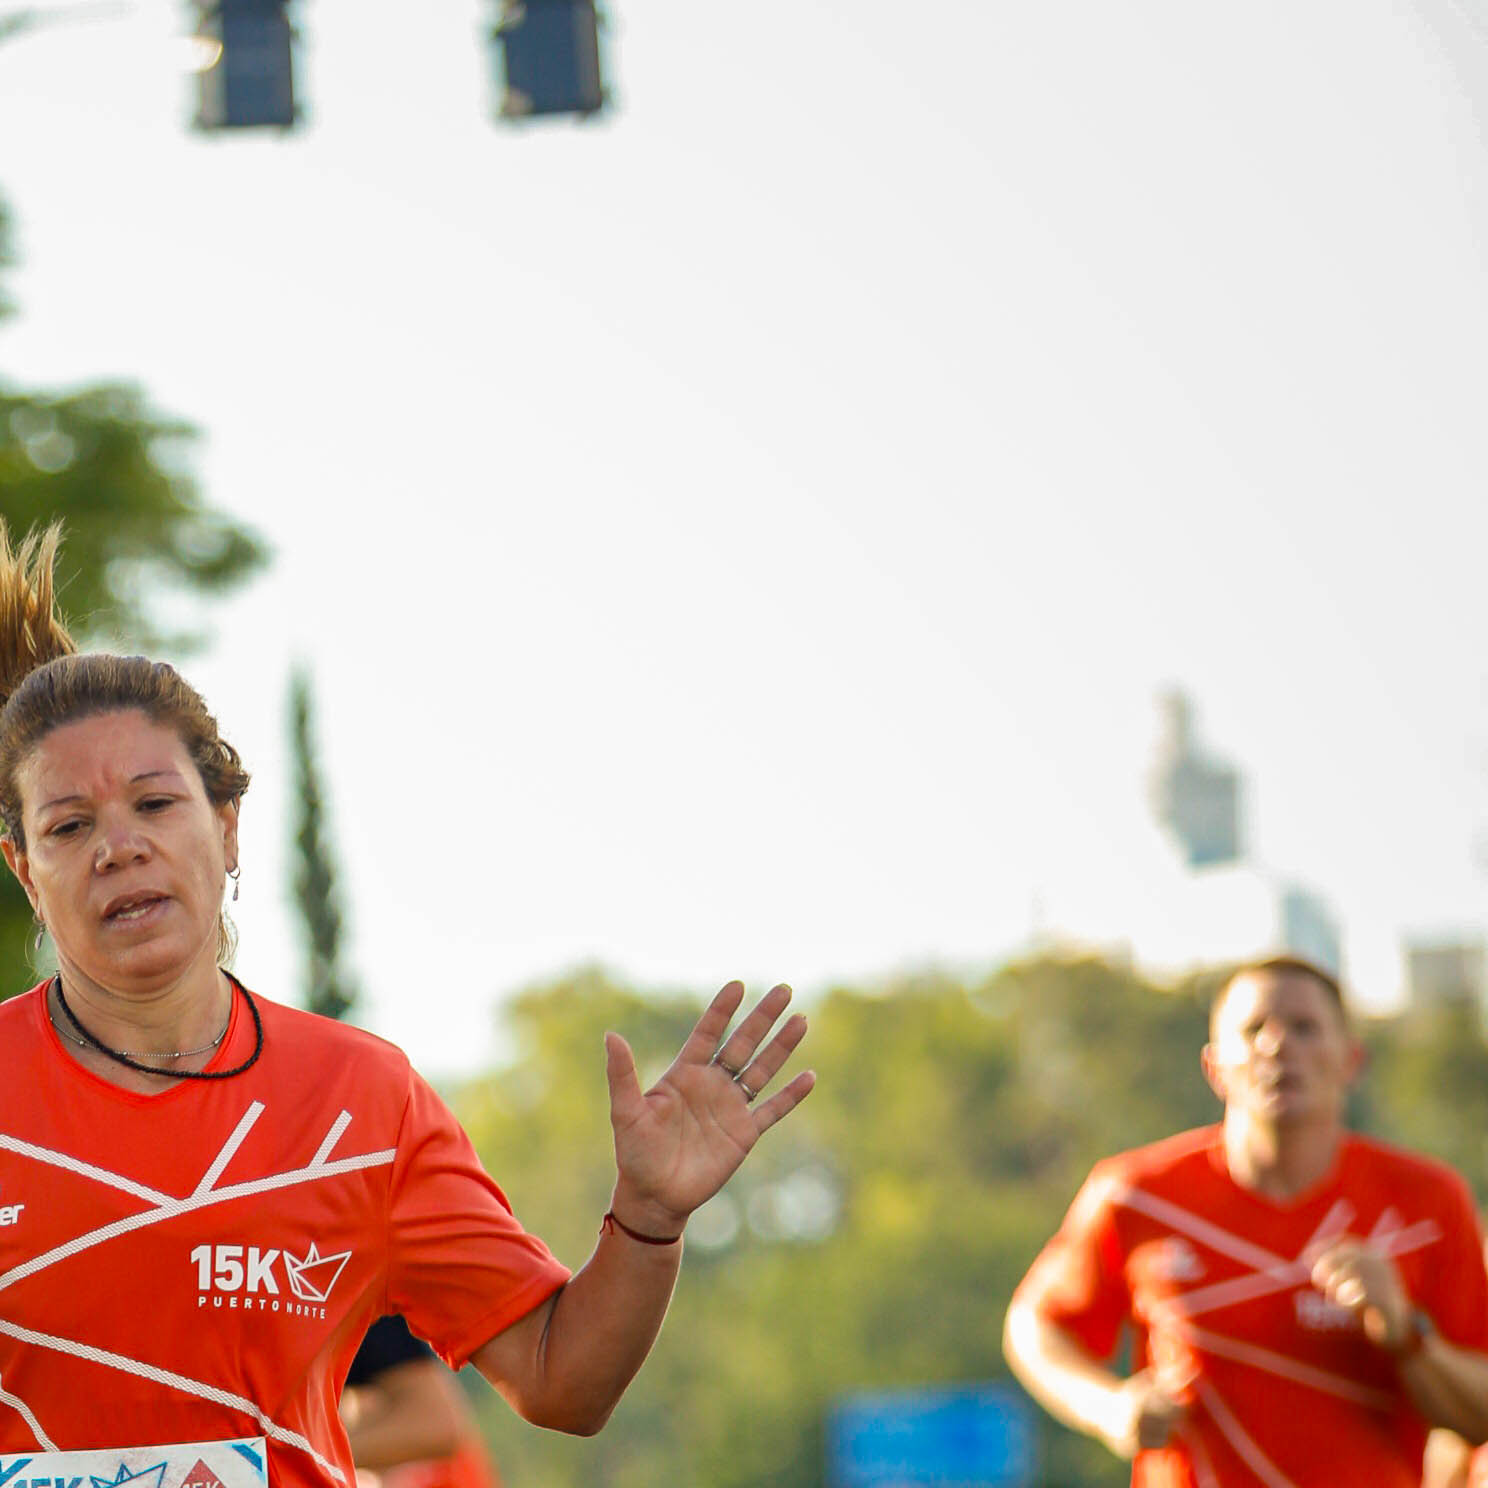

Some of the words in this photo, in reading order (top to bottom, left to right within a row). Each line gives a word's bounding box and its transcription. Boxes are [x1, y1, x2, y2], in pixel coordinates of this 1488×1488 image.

[191, 1244, 280, 1294] 15K
[198, 1296, 280, 1312] PUERTO
[286, 1302, 327, 1319] NORTE
